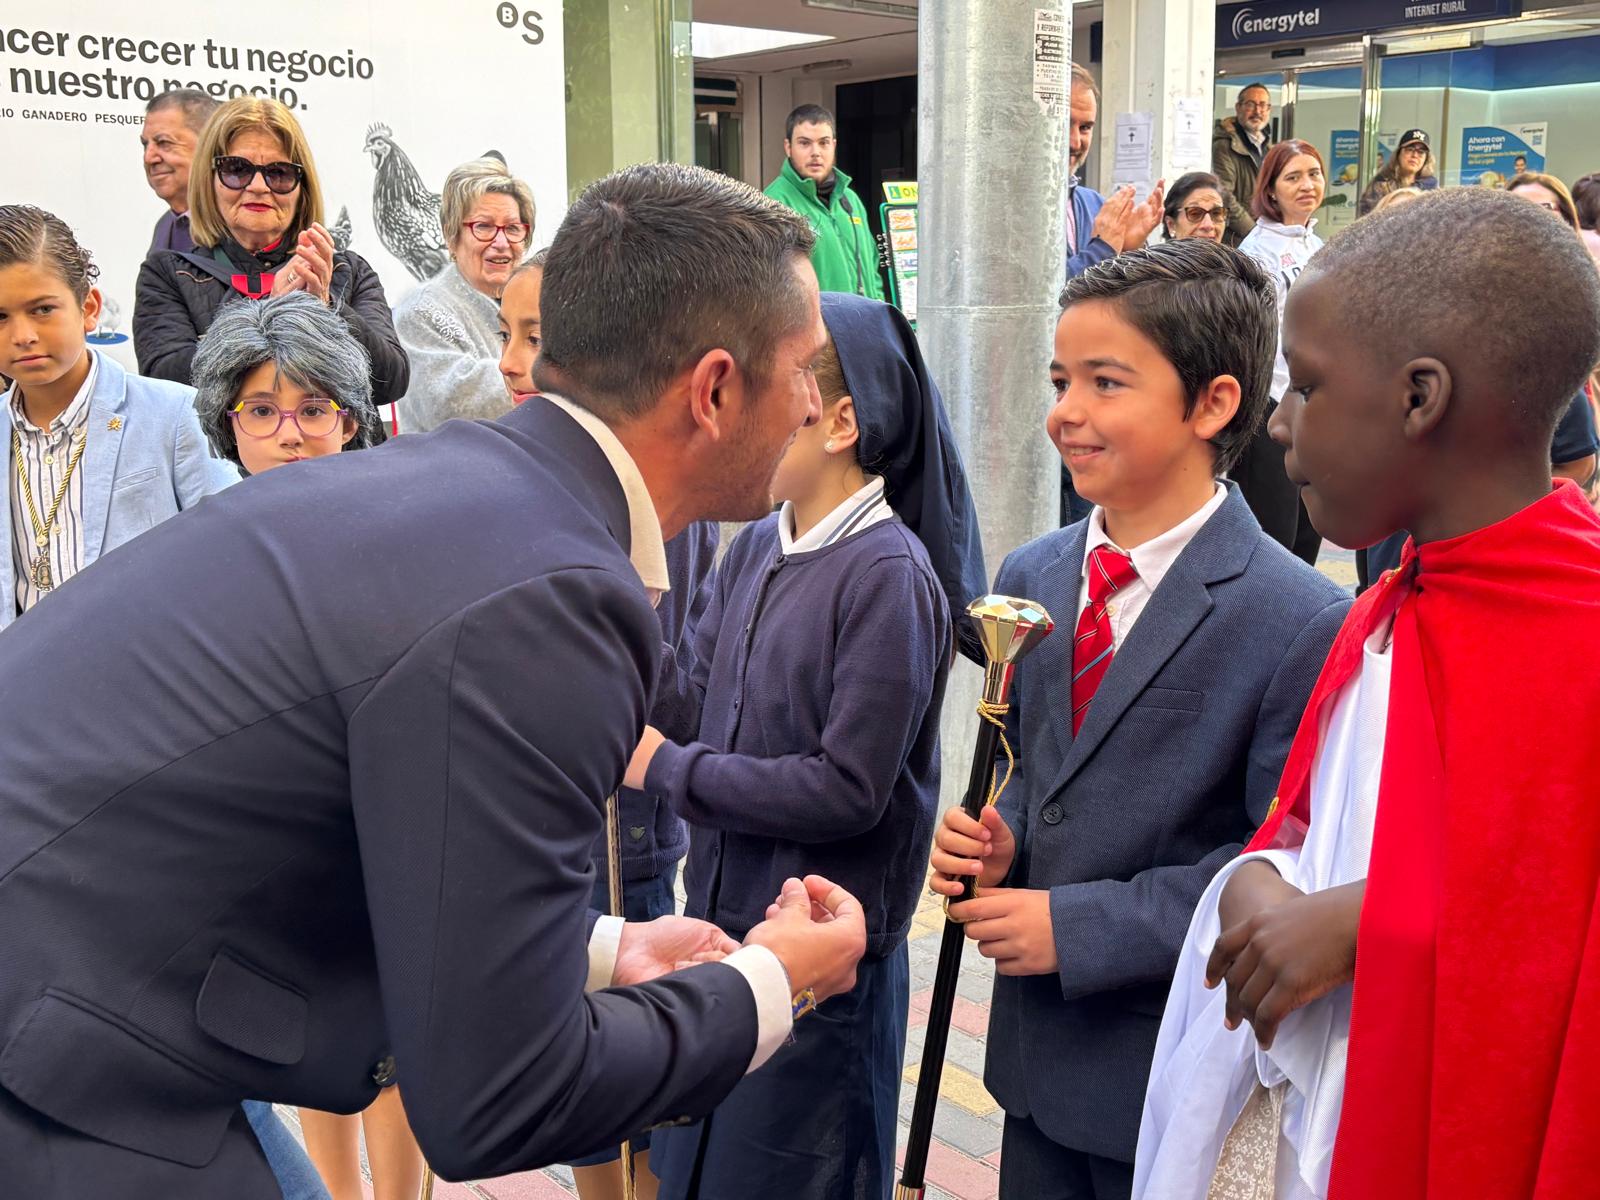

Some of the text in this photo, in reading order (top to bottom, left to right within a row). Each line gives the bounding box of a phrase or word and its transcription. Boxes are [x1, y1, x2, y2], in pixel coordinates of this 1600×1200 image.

[1404, 0, 1466, 18] INTERNET RURAL
[1243, 8, 1320, 33] energytel
[0, 28, 374, 83] cer crecer tu negocio
[9, 67, 156, 102] nuestro
[0, 108, 14, 118] IO
[22, 109, 88, 122] GANADERO
[1468, 143, 1503, 153] Energytel
